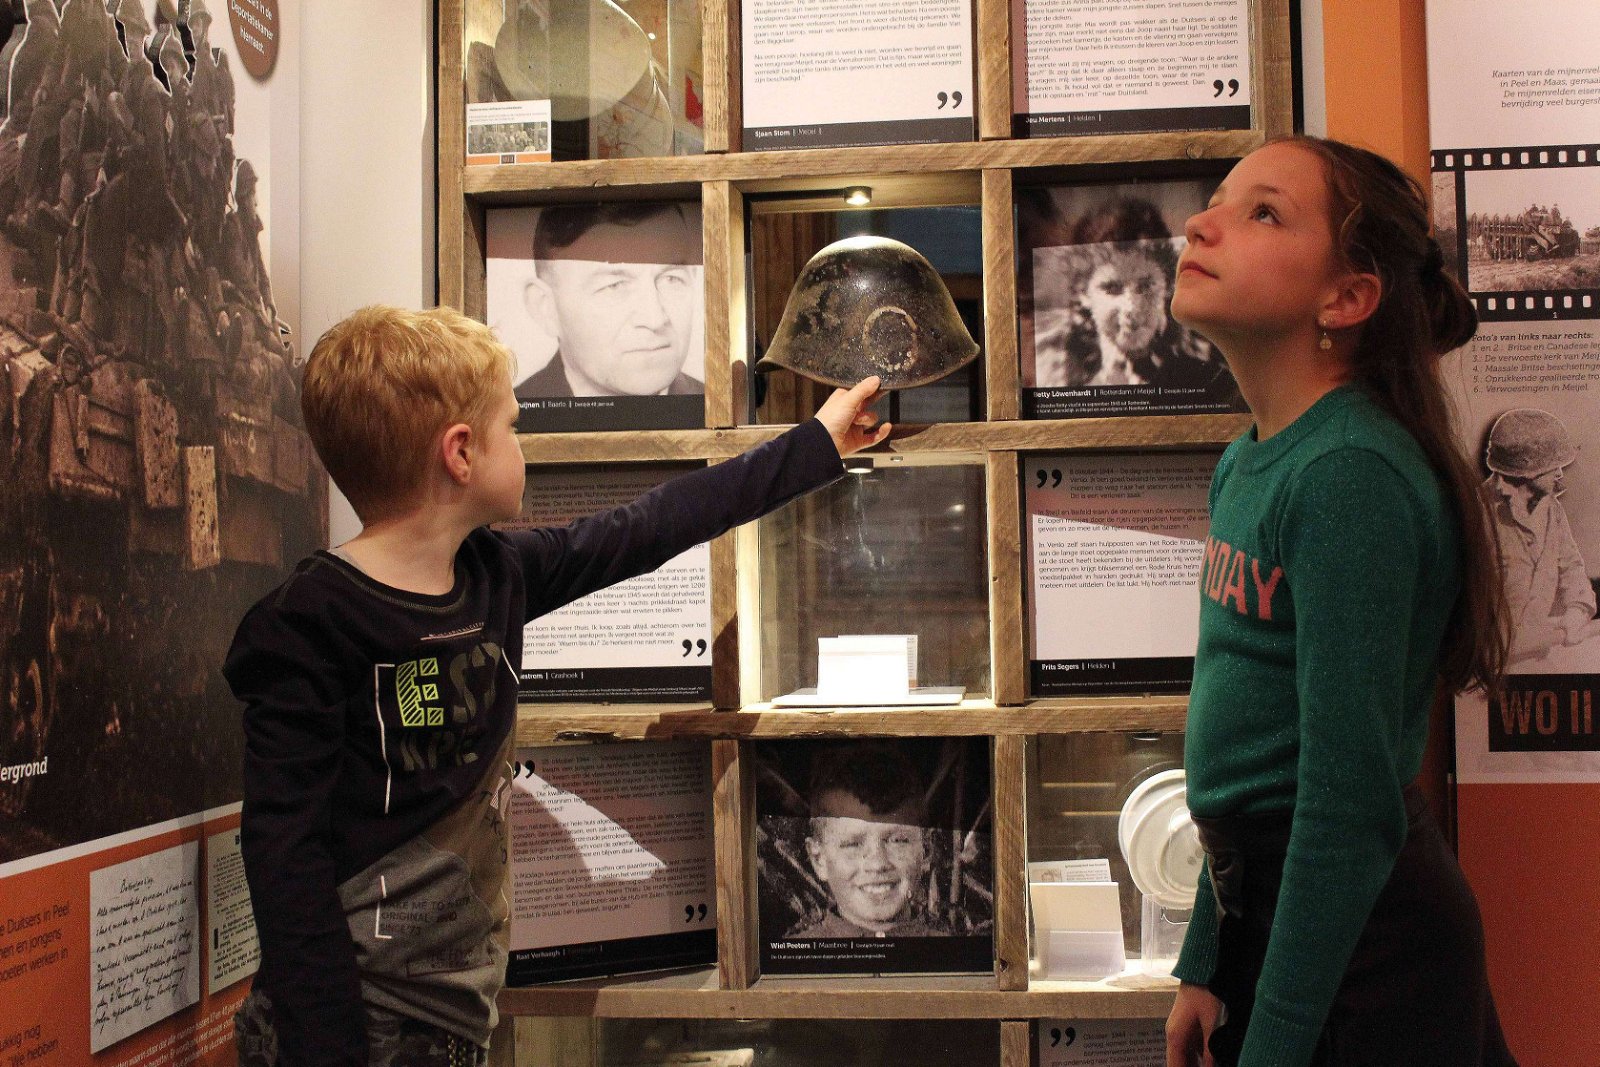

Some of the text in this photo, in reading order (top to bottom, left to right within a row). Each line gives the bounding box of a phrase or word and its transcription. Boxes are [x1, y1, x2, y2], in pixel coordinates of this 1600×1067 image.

[1492, 70, 1524, 78] Kaarten
[1544, 68, 1555, 76] de
[1510, 79, 1529, 88] Peel
[1504, 90, 1514, 98] De
[1518, 88, 1576, 98] mijnenvelden
[1502, 99, 1544, 109] bevrijding
[1038, 114, 1065, 122] Mertens
[1472, 333, 1498, 342] Foto's
[1518, 332, 1540, 340] links
[1564, 332, 1594, 340] rechts:
[1508, 343, 1533, 351] Britse
[1544, 352, 1561, 360] kerk
[1520, 363, 1544, 371] Britse
[1485, 374, 1537, 383] Oprukkende
[1486, 385, 1550, 394] Verwoestingen
[1551, 384, 1560, 392] in
[1052, 390, 1091, 398] Löwenhardt
[1057, 664, 1080, 672] Segers
[1499, 690, 1592, 735] WO II
[0, 756, 48, 784] ergrond
